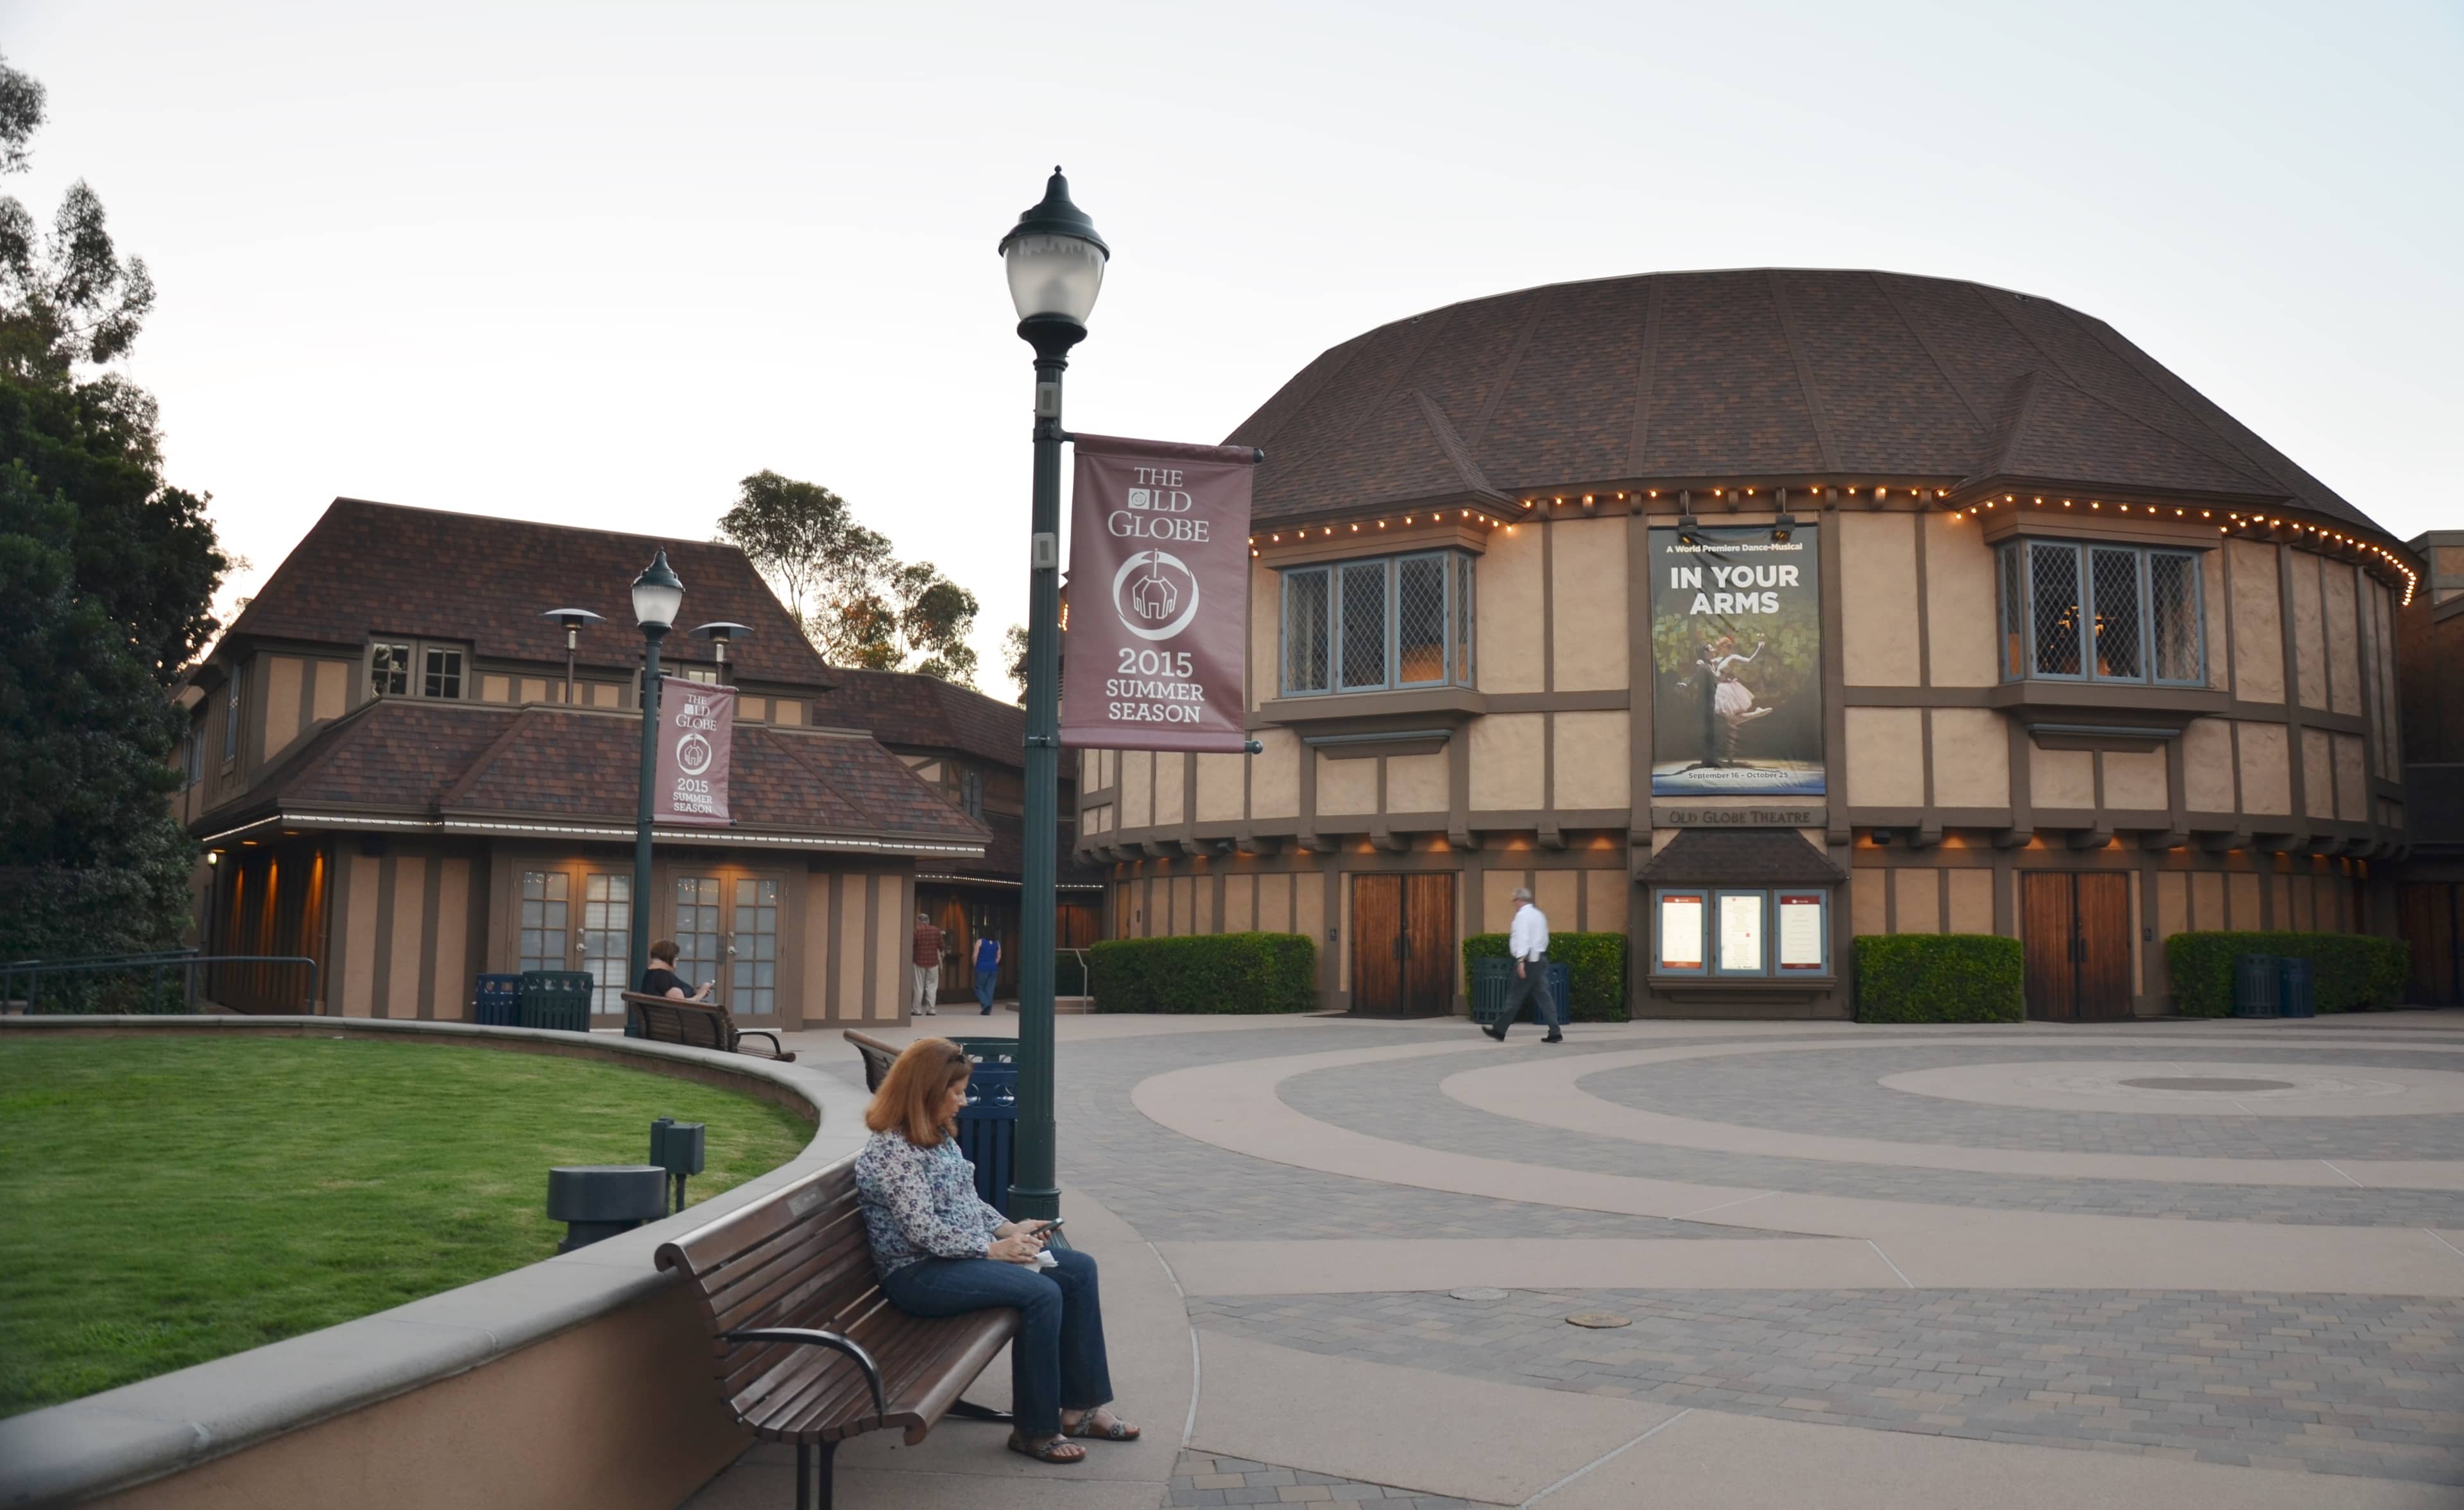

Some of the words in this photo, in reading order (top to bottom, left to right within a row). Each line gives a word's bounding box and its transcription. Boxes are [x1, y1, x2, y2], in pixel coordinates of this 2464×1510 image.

[1134, 467, 1183, 487] THE
[1108, 511, 1209, 542] GLOBE
[1742, 543, 1802, 551] Dance-Musical
[1671, 567, 1702, 588] IN
[1711, 565, 1799, 588] YOUR
[1690, 591, 1779, 615] ARMS
[1118, 647, 1192, 678] 2015
[687, 694, 706, 704] THE
[1106, 679, 1204, 701] SUMMER
[1109, 702, 1199, 723] SEASON
[676, 714, 717, 731] GLOBE
[678, 778, 708, 792] 2015
[673, 792, 712, 804] SUMMER
[674, 802, 712, 813] SEASON
[1670, 811, 1697, 823] OLD
[1703, 811, 1747, 823] GLOBE
[1750, 811, 1810, 822] THEATRE
